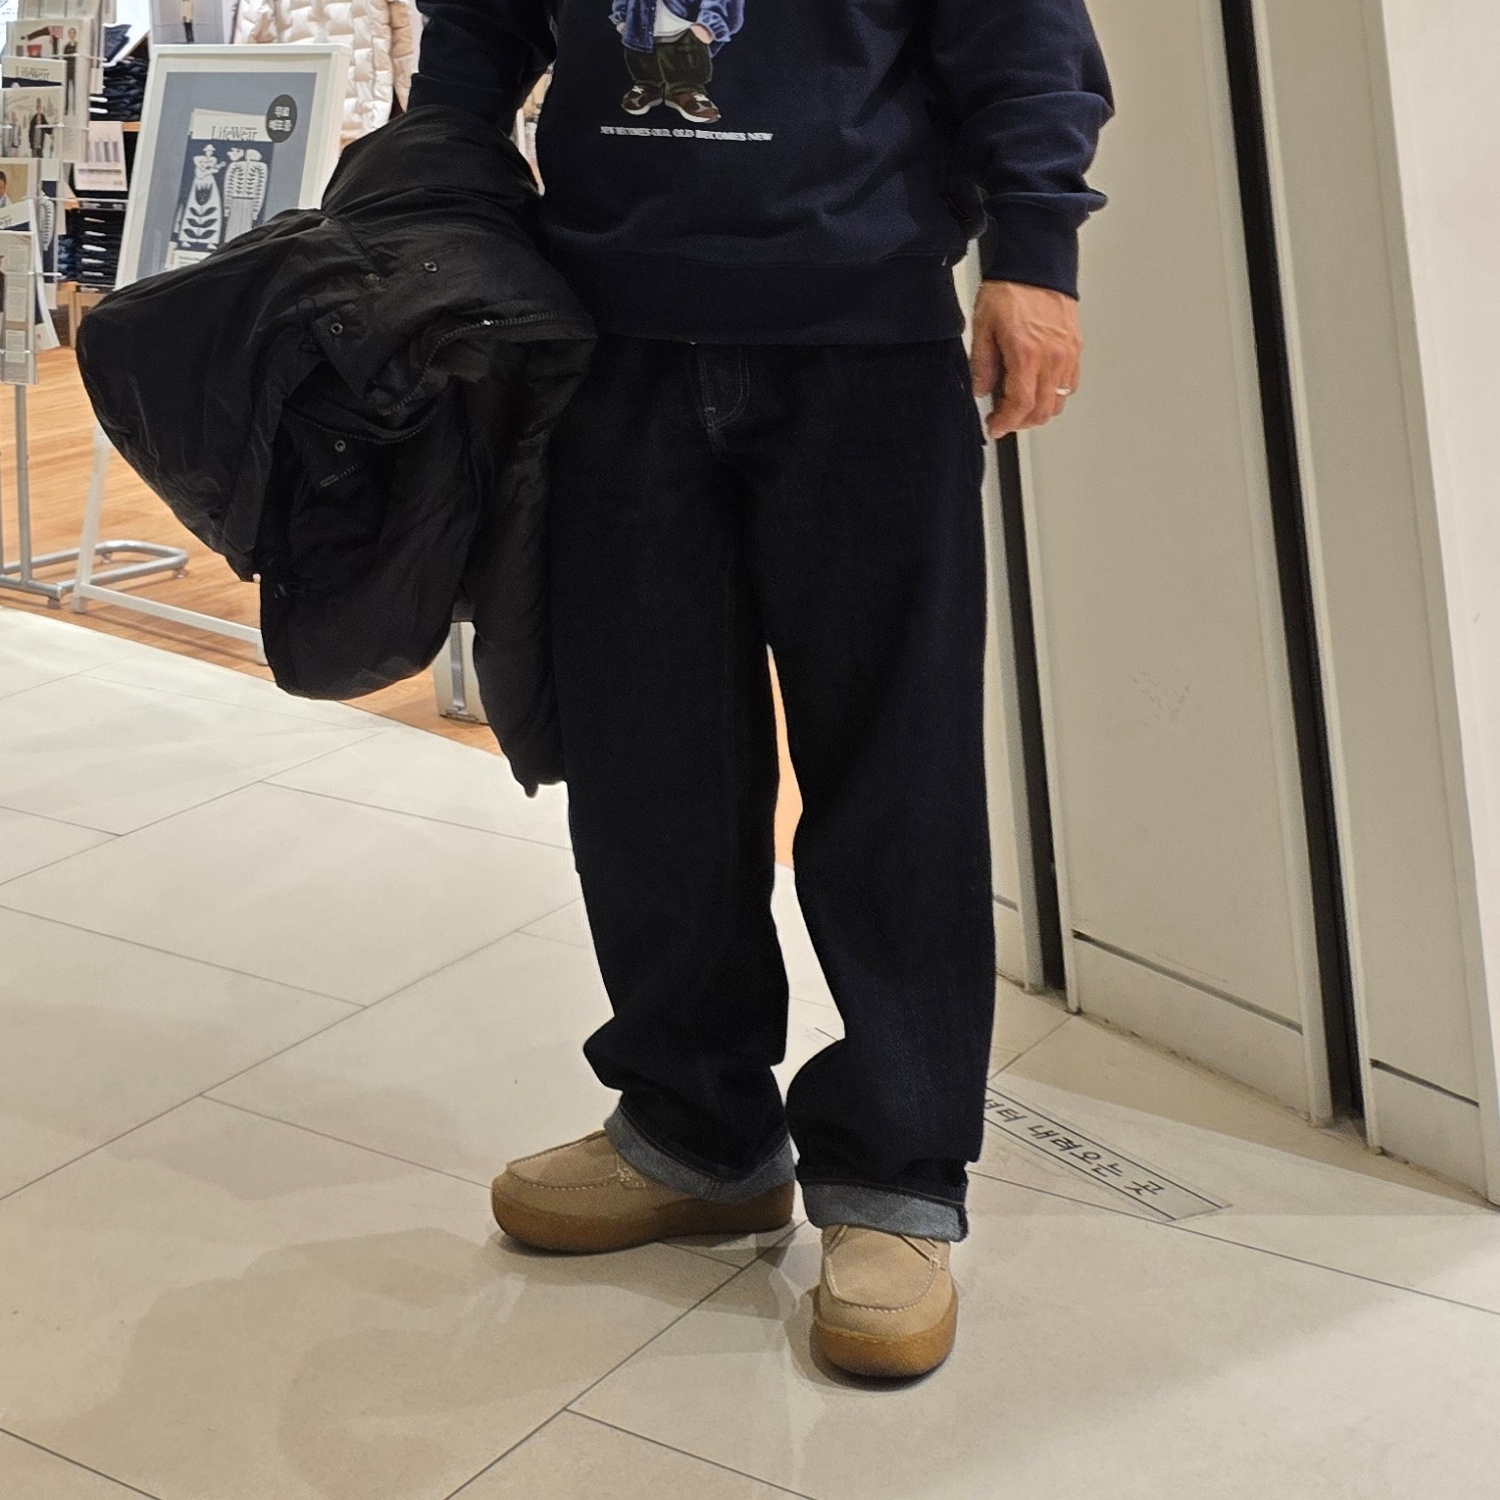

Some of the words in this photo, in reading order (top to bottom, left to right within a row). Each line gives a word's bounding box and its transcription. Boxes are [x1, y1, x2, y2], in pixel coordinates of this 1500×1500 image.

[211, 125, 258, 142] LifeWear
[672, 128, 695, 138] OLD
[695, 130, 747, 142] BECOMES
[747, 132, 774, 141] NEW
[1027, 1124, 1123, 1177] 내려오는
[1124, 1180, 1165, 1196] 곳
